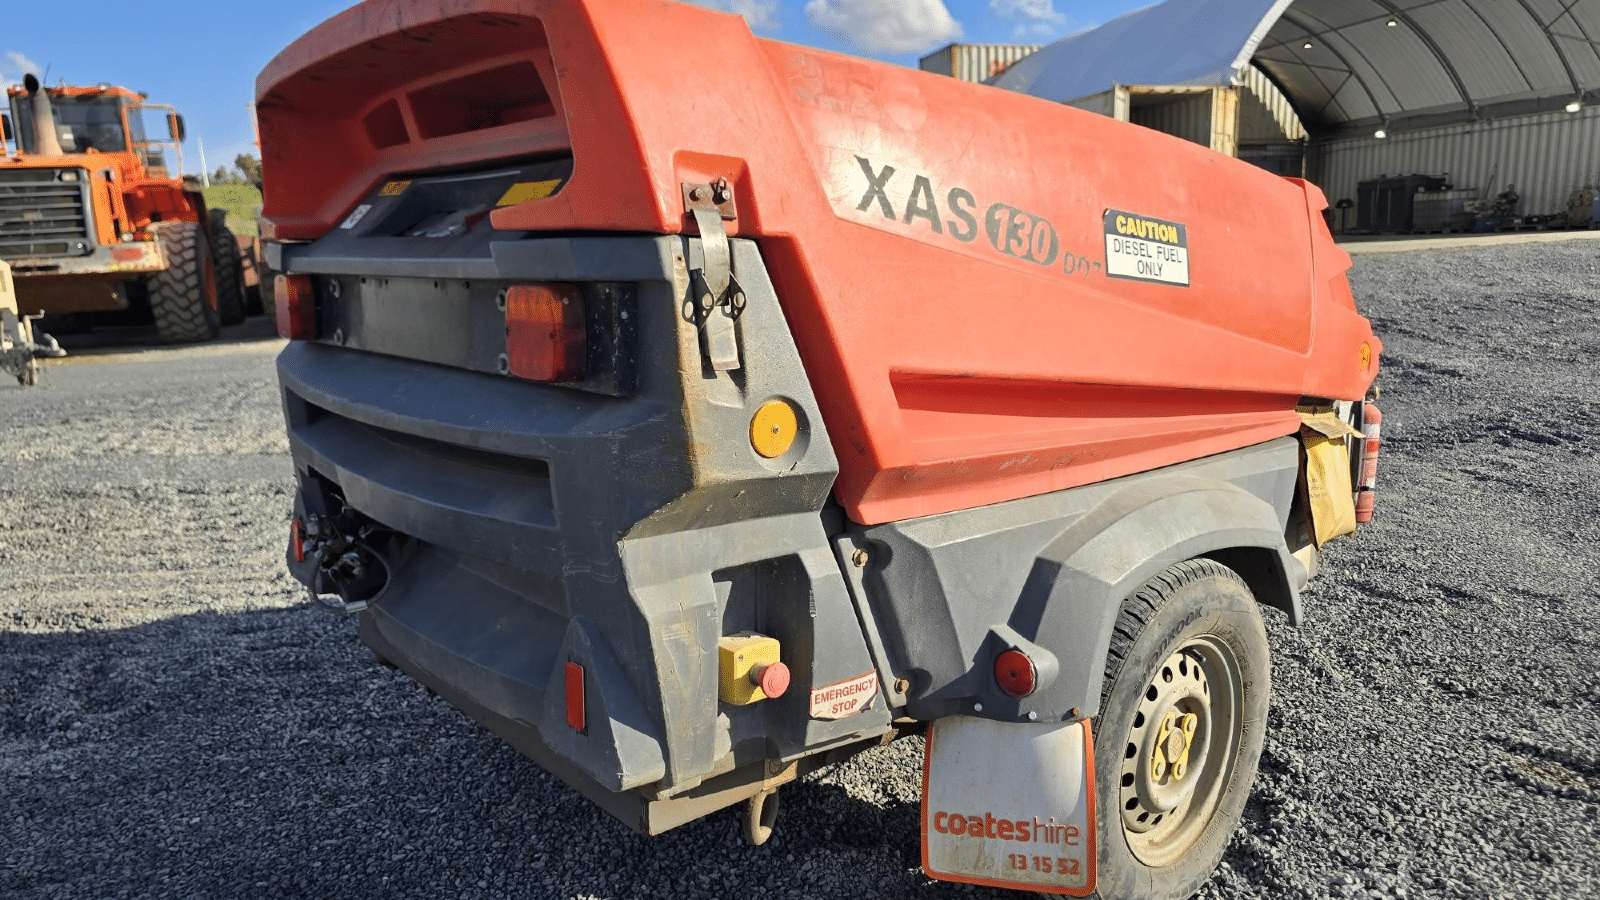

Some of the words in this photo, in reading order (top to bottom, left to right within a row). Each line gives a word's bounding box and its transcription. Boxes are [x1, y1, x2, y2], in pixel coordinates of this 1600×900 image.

[853, 154, 978, 243] XAS
[994, 207, 1053, 265] 130
[1115, 214, 1178, 244] CAUTION
[1113, 238, 1153, 258] DIESEL
[1157, 245, 1183, 263] FUEL
[1137, 260, 1163, 277] ONLY
[814, 677, 875, 705] EMERGENCY
[831, 698, 858, 714] STOP
[1008, 853, 1028, 871] 13
[1033, 856, 1052, 873] 15
[1057, 857, 1080, 875] 52
